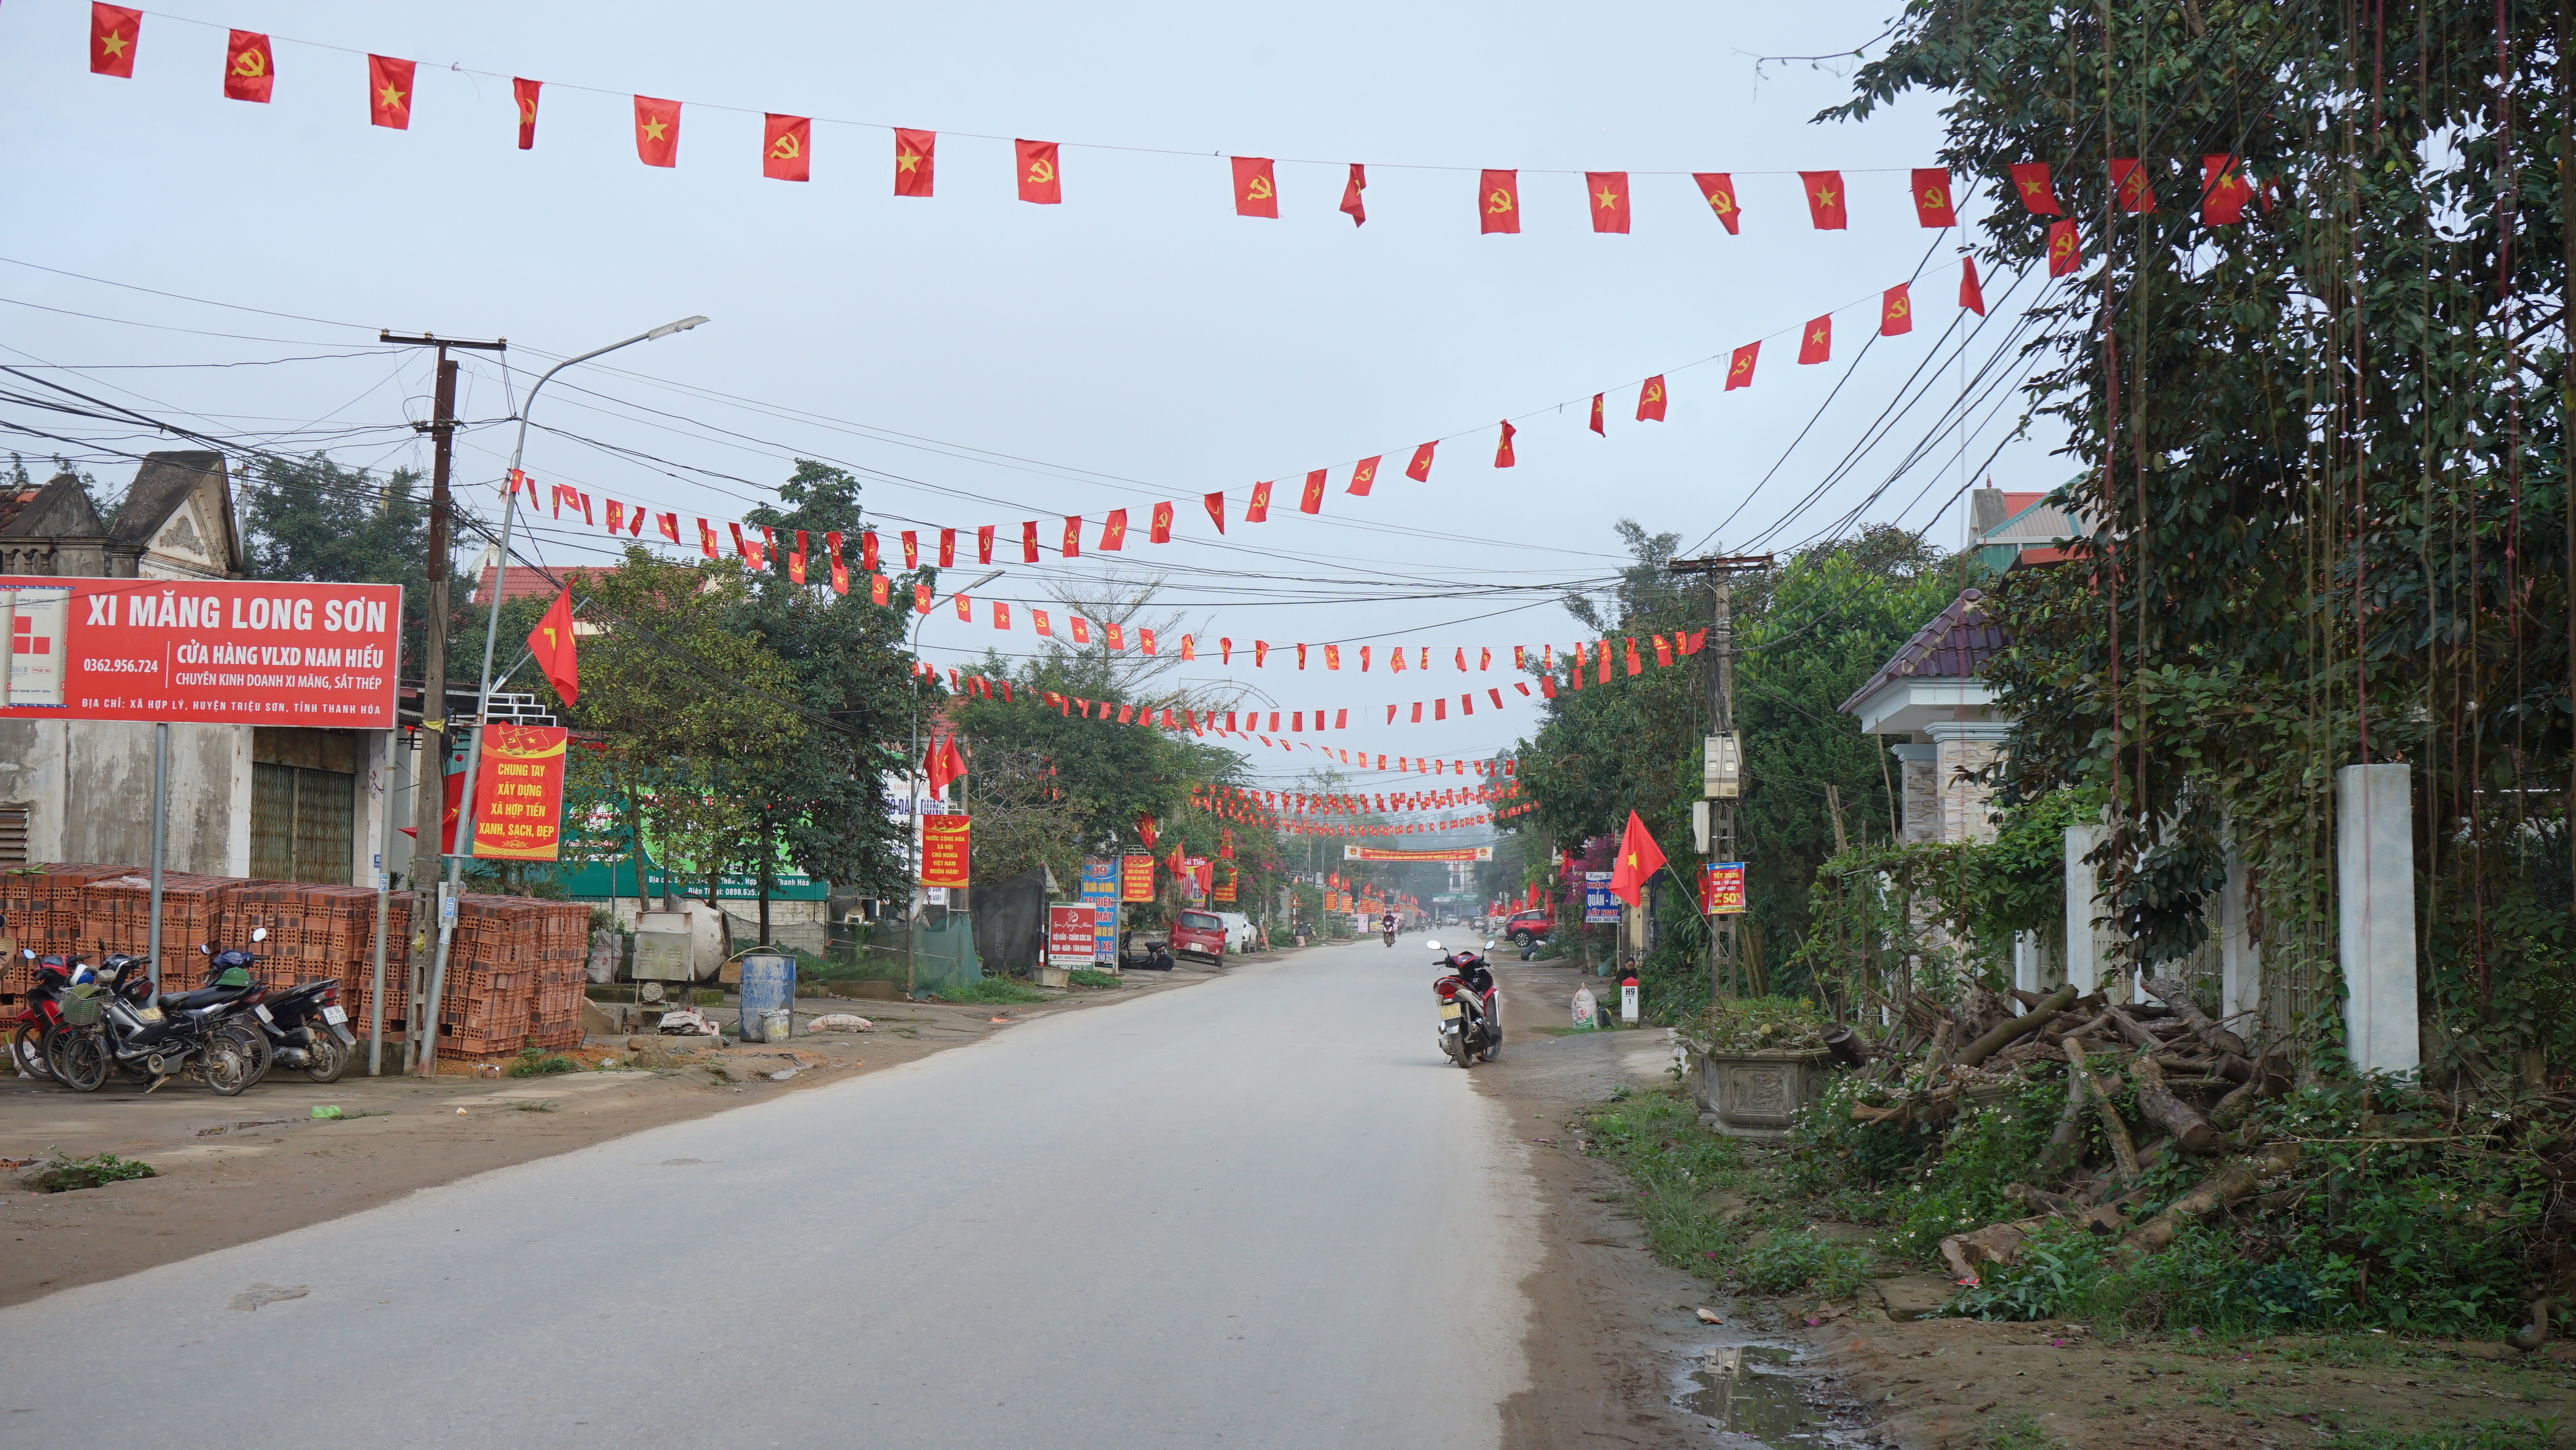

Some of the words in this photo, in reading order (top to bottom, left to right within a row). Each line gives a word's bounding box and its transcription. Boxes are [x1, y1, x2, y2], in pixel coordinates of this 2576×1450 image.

[86, 594, 117, 626] XI
[129, 590, 221, 628] MĂNG
[232, 597, 313, 630] LONG
[324, 596, 387, 632] SƠN
[177, 639, 209, 663] CỬA
[213, 642, 258, 665] HÀNG
[261, 646, 301, 666] VLXD
[304, 648, 341, 667] NAM
[345, 643, 384, 669] HIẾU
[84, 658, 158, 673] 0362.956.724
[175, 671, 217, 685] CHUYÊN
[219, 673, 244, 686] KINH
[246, 674, 283, 688] DOANH
[285, 675, 295, 687] XI
[298, 673, 332, 690] MĂNG,
[334, 673, 353, 689] SẮT
[355, 675, 382, 690] THÉP
[82, 698, 99, 709] ĐỊA
[103, 697, 125, 708] CHỈ:
[130, 698, 143, 709] XÃ
[148, 700, 168, 711] HỢP
[172, 699, 188, 711] LÝ,
[193, 700, 226, 712] HUYỆN
[231, 701, 260, 713] TRIỆU
[265, 702, 289, 713] SƠN,
[294, 701, 317, 713] TỈNH
[322, 704, 356, 713] THANH
[361, 704, 380, 715] HÓA
[498, 764, 528, 776] CHUNG
[531, 765, 545, 777] TAY
[497, 781, 516, 796] XÂY
[517, 783, 542, 798] DỰNG
[490, 801, 503, 815] XÃ
[505, 803, 523, 818] HỢP
[526, 802, 545, 817] TIẾN
[478, 822, 505, 836] XANH,
[507, 824, 534, 838] SẠCH,
[537, 825, 554, 840] ĐẸP
[1091, 866, 1107, 876] 99
[649, 875, 659, 884] Địa
[1095, 895, 1114, 909] ĐIỆN
[1723, 893, 1740, 904] 50%
[1587, 907, 1600, 915] LẤY
[1101, 941, 1113, 951] XE
